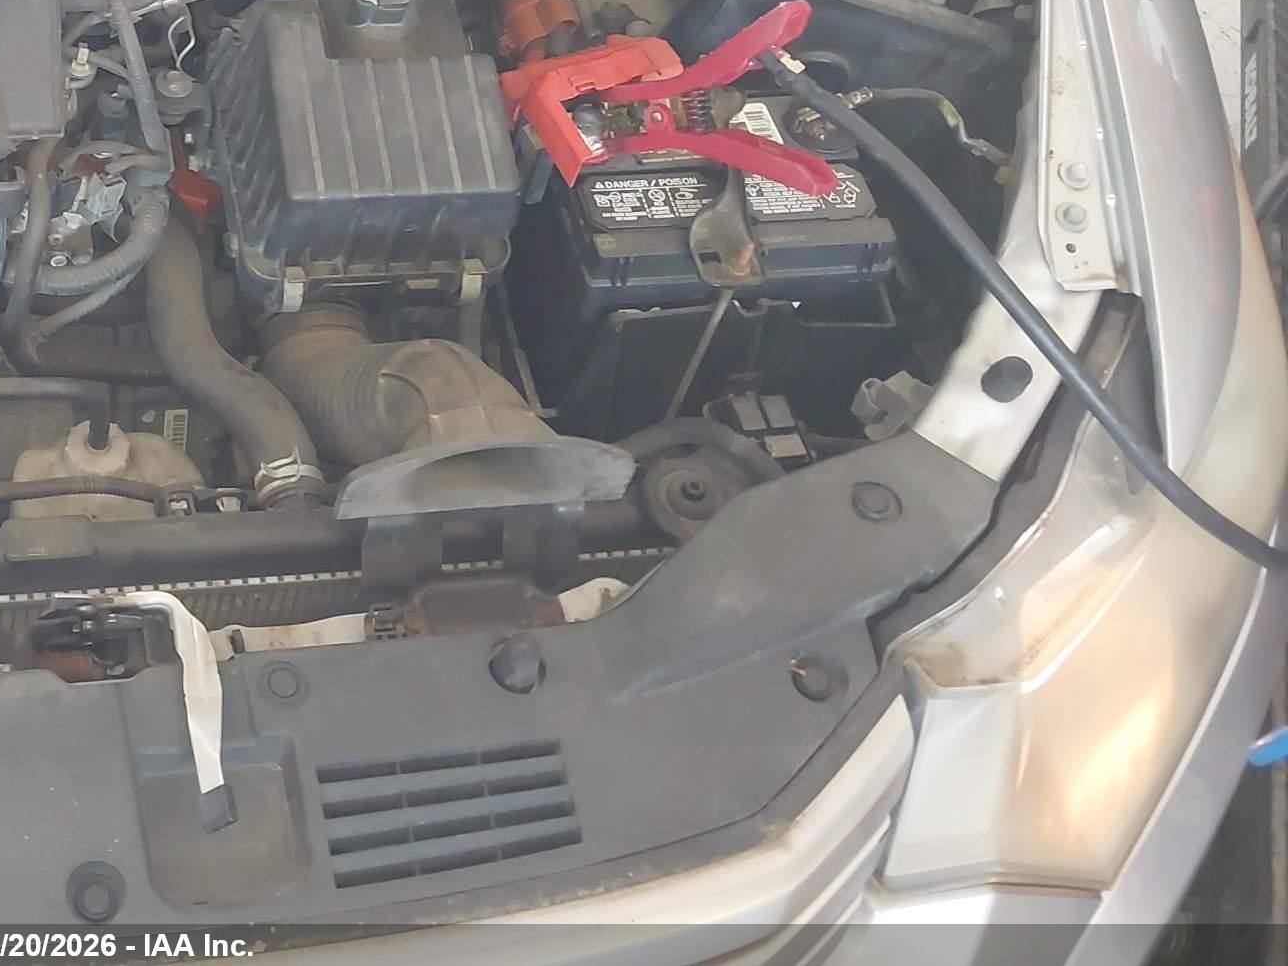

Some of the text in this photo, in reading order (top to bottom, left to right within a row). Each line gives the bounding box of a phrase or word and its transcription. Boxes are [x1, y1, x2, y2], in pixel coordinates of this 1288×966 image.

[605, 177, 698, 189] DANGER / POISON
